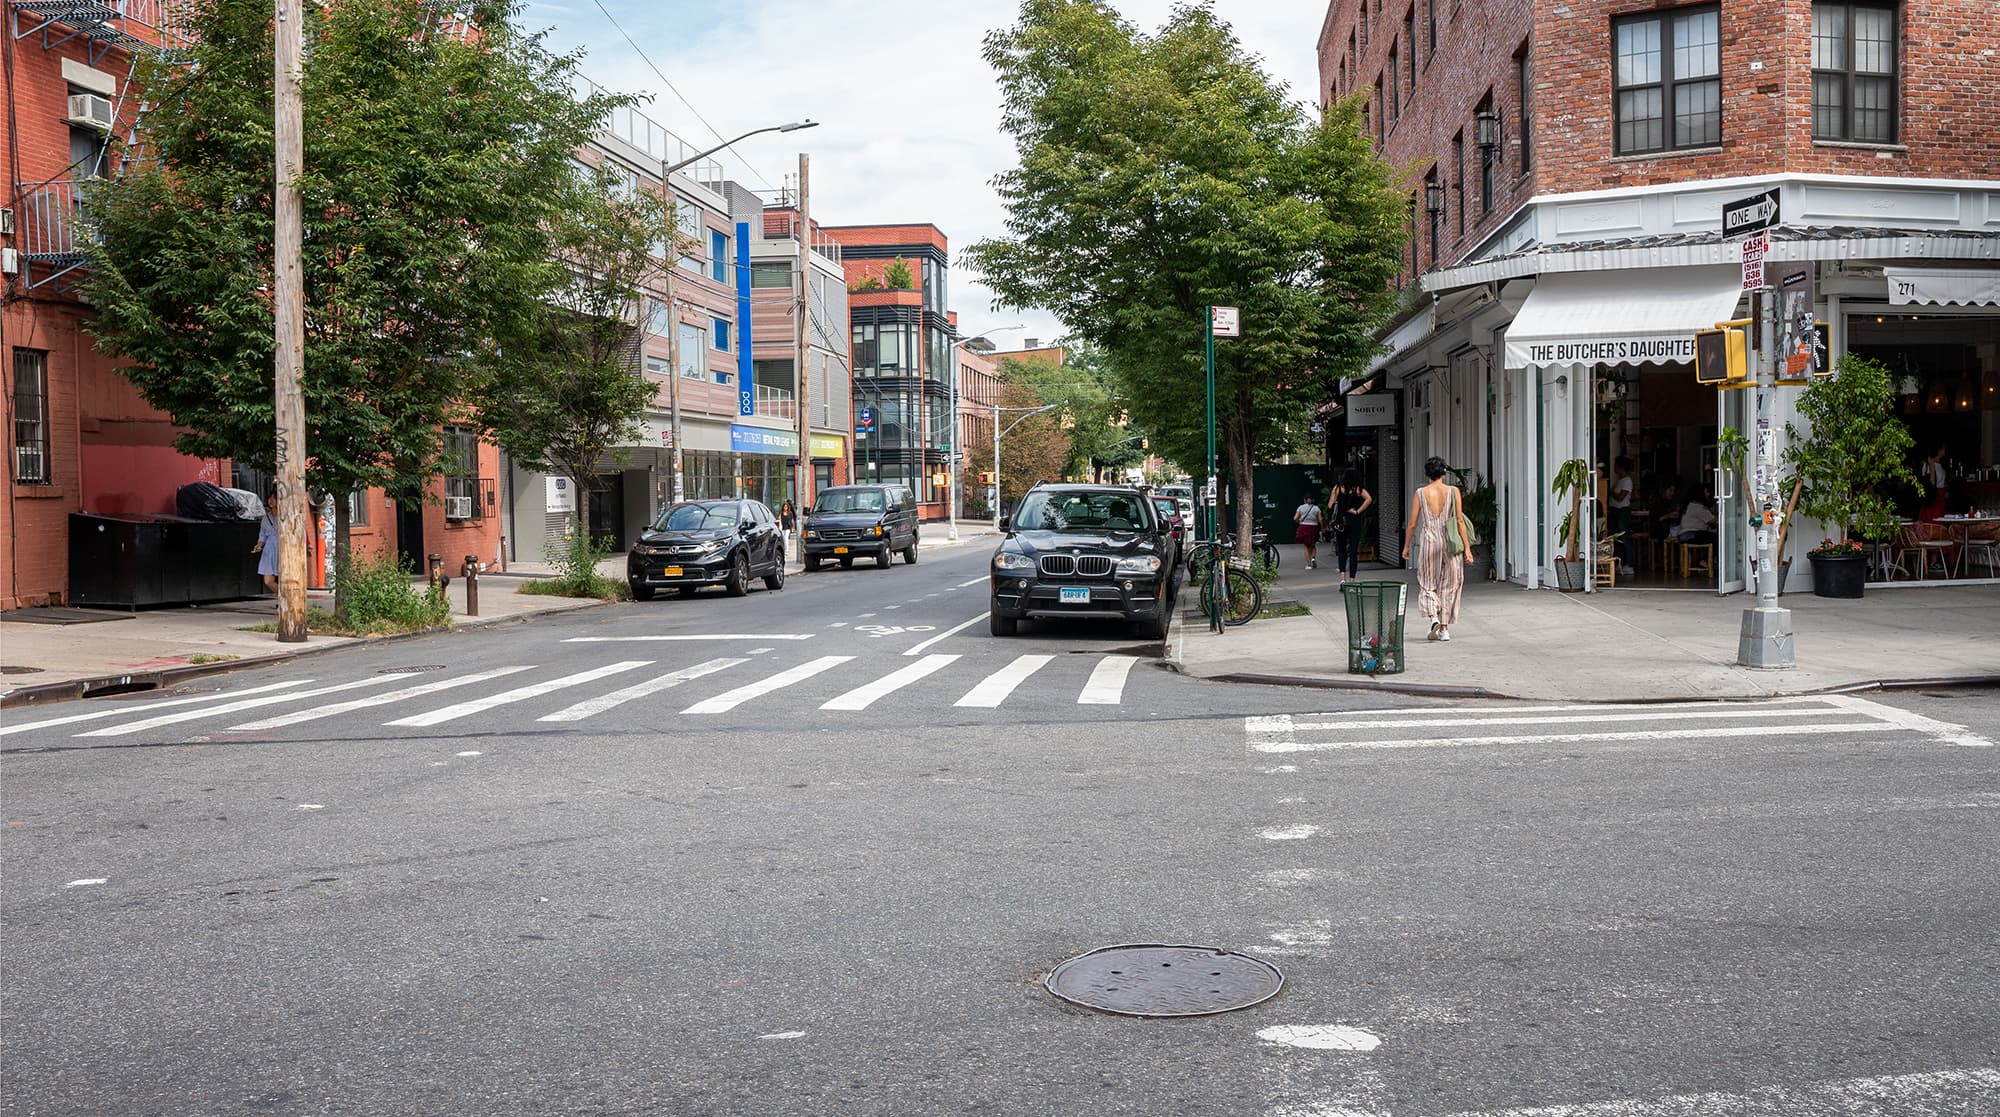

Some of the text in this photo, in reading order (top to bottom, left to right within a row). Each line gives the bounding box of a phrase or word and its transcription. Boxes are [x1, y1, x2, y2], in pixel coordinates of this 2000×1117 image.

[1731, 201, 1773, 226] ONE WAY
[1743, 237, 1763, 251] CASH
[1744, 261, 1762, 272] (516)
[1745, 269, 1761, 280] 636
[1743, 278, 1763, 289] 9595
[1898, 282, 1915, 296] 271
[1530, 345, 1554, 361] THE
[1557, 342, 1627, 360] BUTCHER'S
[742, 391, 751, 413] pod
